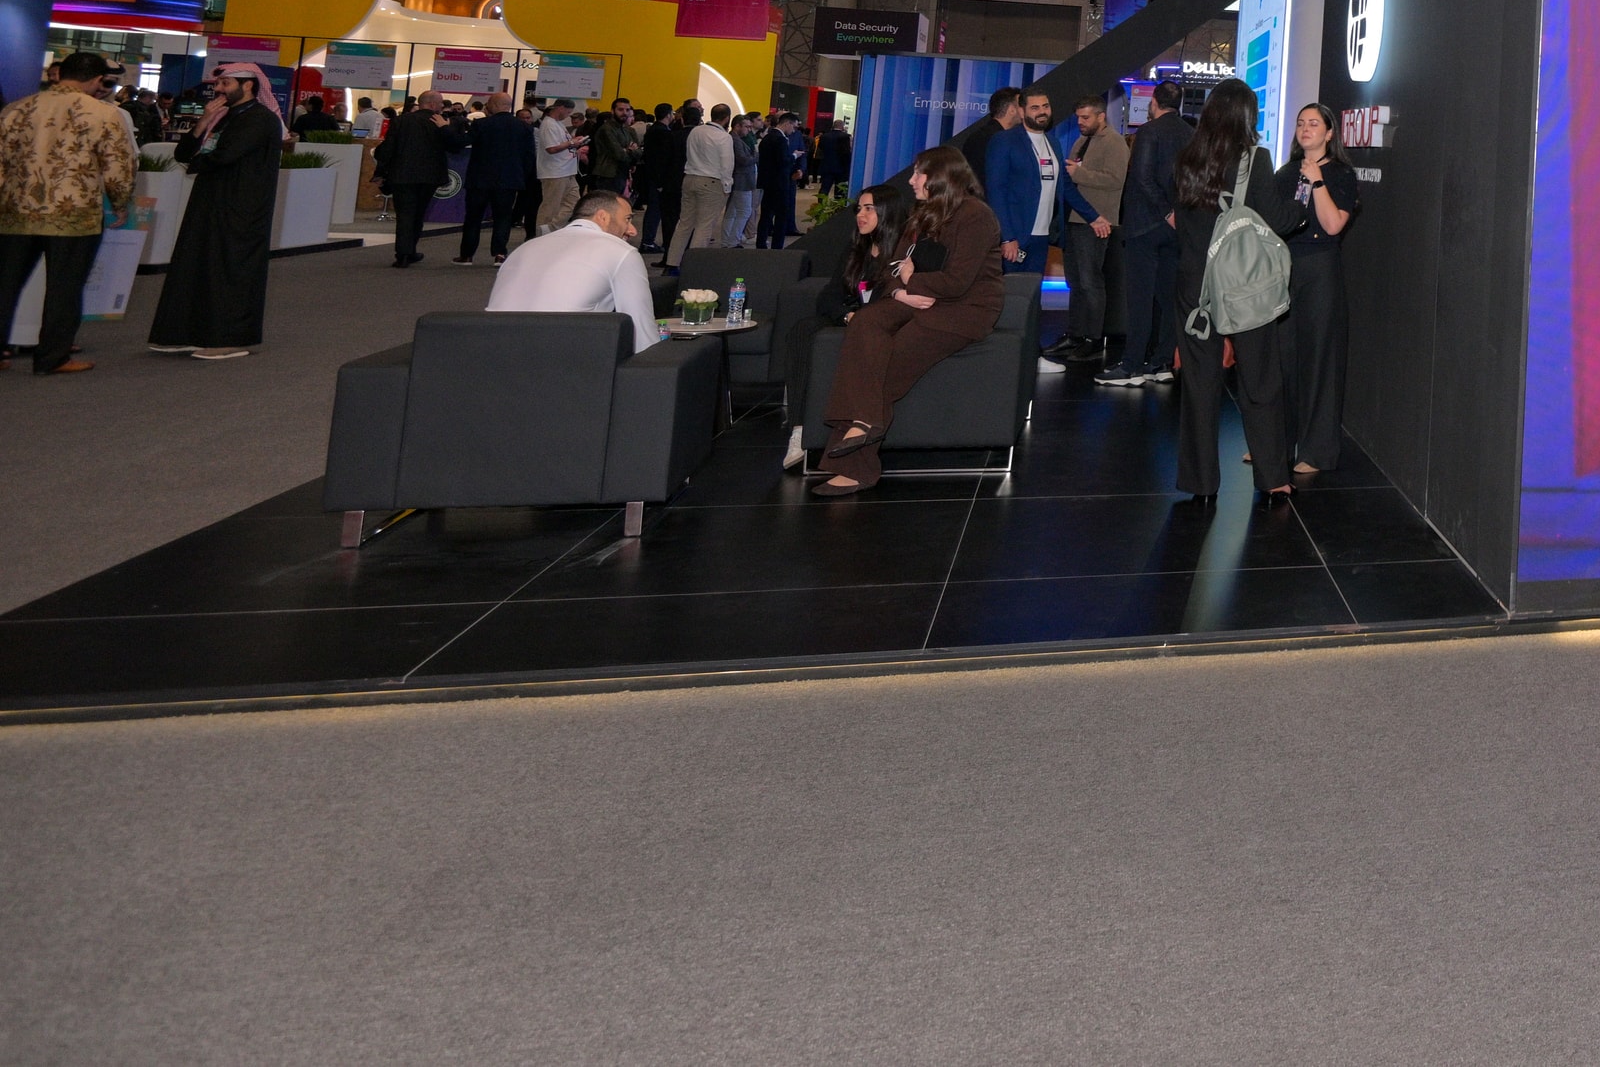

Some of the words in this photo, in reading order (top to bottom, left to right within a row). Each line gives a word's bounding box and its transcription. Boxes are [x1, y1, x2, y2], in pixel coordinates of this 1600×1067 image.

[834, 21, 857, 31] Data
[859, 22, 900, 35] Security
[836, 33, 895, 45] Everywhere
[436, 72, 463, 81] bulbi
[914, 96, 988, 114] Empowering
[1341, 104, 1384, 148] GROUP
